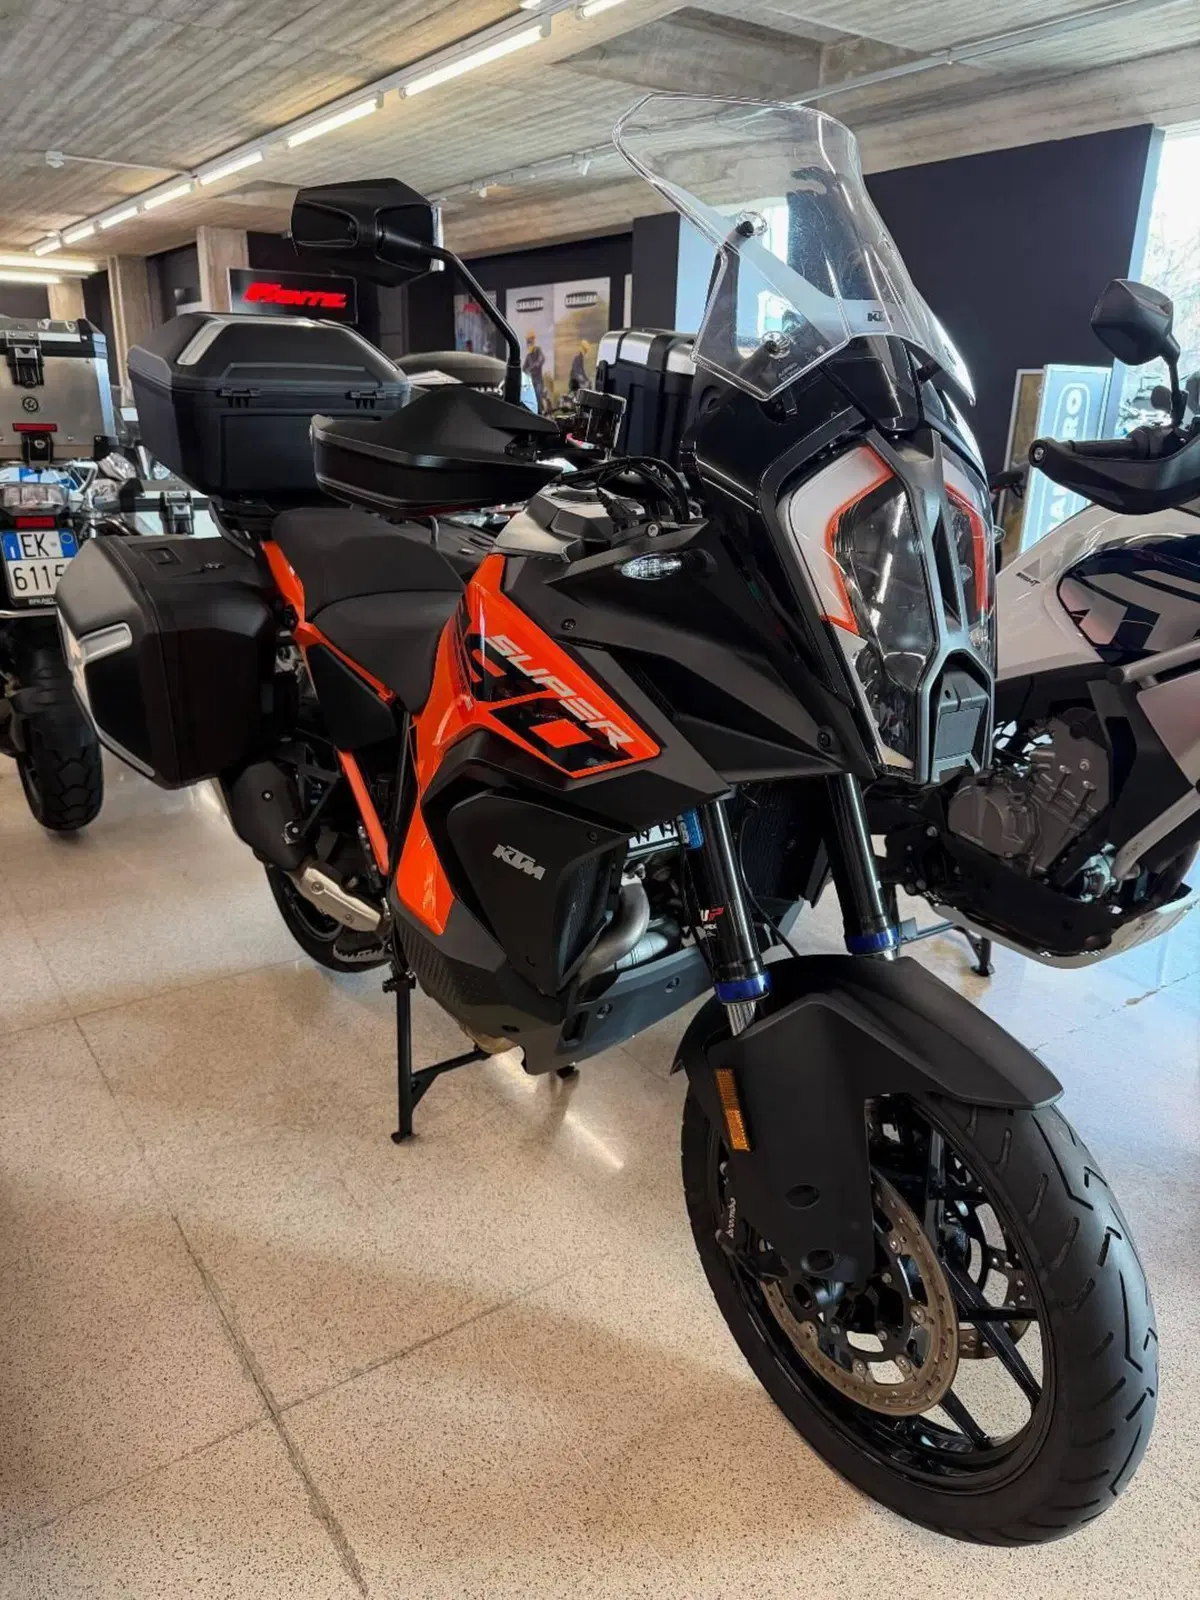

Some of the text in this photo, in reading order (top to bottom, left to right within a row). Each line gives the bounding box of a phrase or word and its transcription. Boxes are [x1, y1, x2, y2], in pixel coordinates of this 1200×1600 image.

[20, 532, 50, 558] EK
[485, 634, 635, 750] SUPER
[492, 843, 547, 881] KTM
